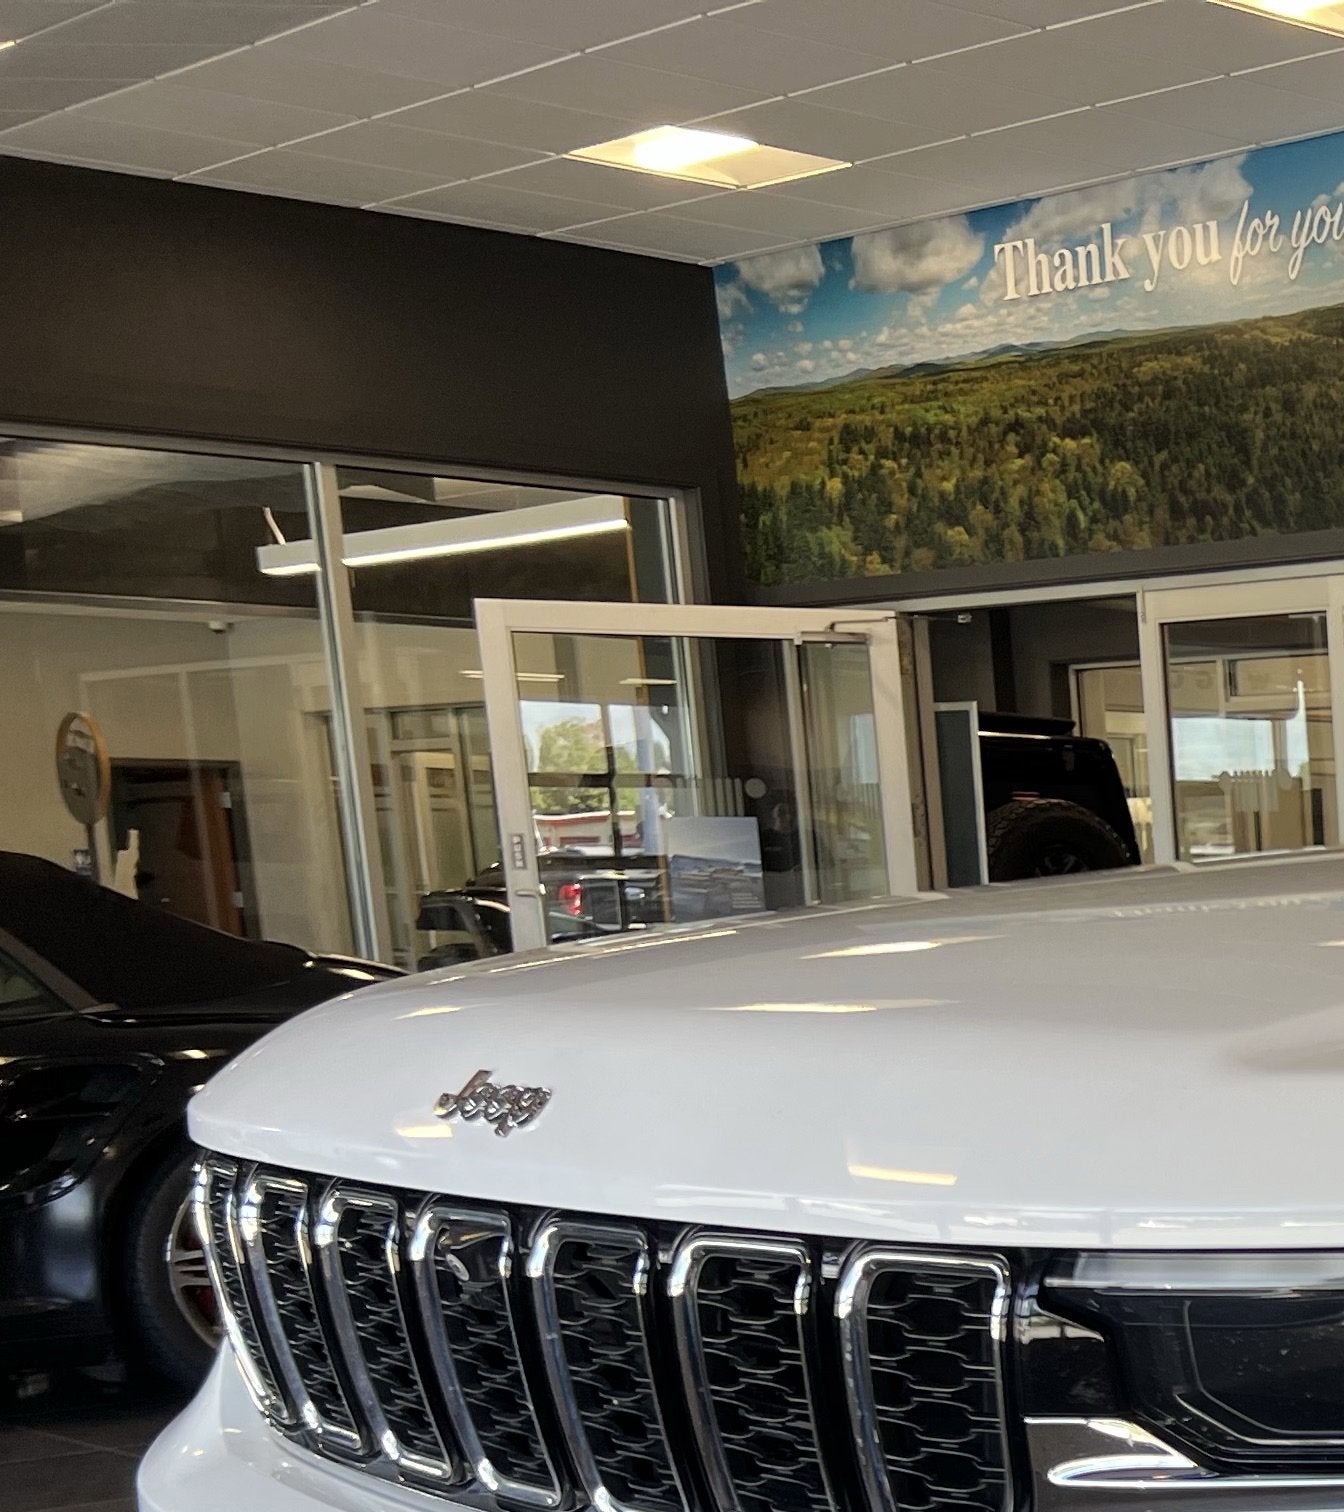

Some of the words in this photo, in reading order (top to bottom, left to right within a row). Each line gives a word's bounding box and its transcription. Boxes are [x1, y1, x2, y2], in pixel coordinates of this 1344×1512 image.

[994, 223, 1130, 301] Thank
[1143, 220, 1222, 292] you
[1230, 200, 1283, 286] for
[433, 1069, 552, 1137] Jeep
